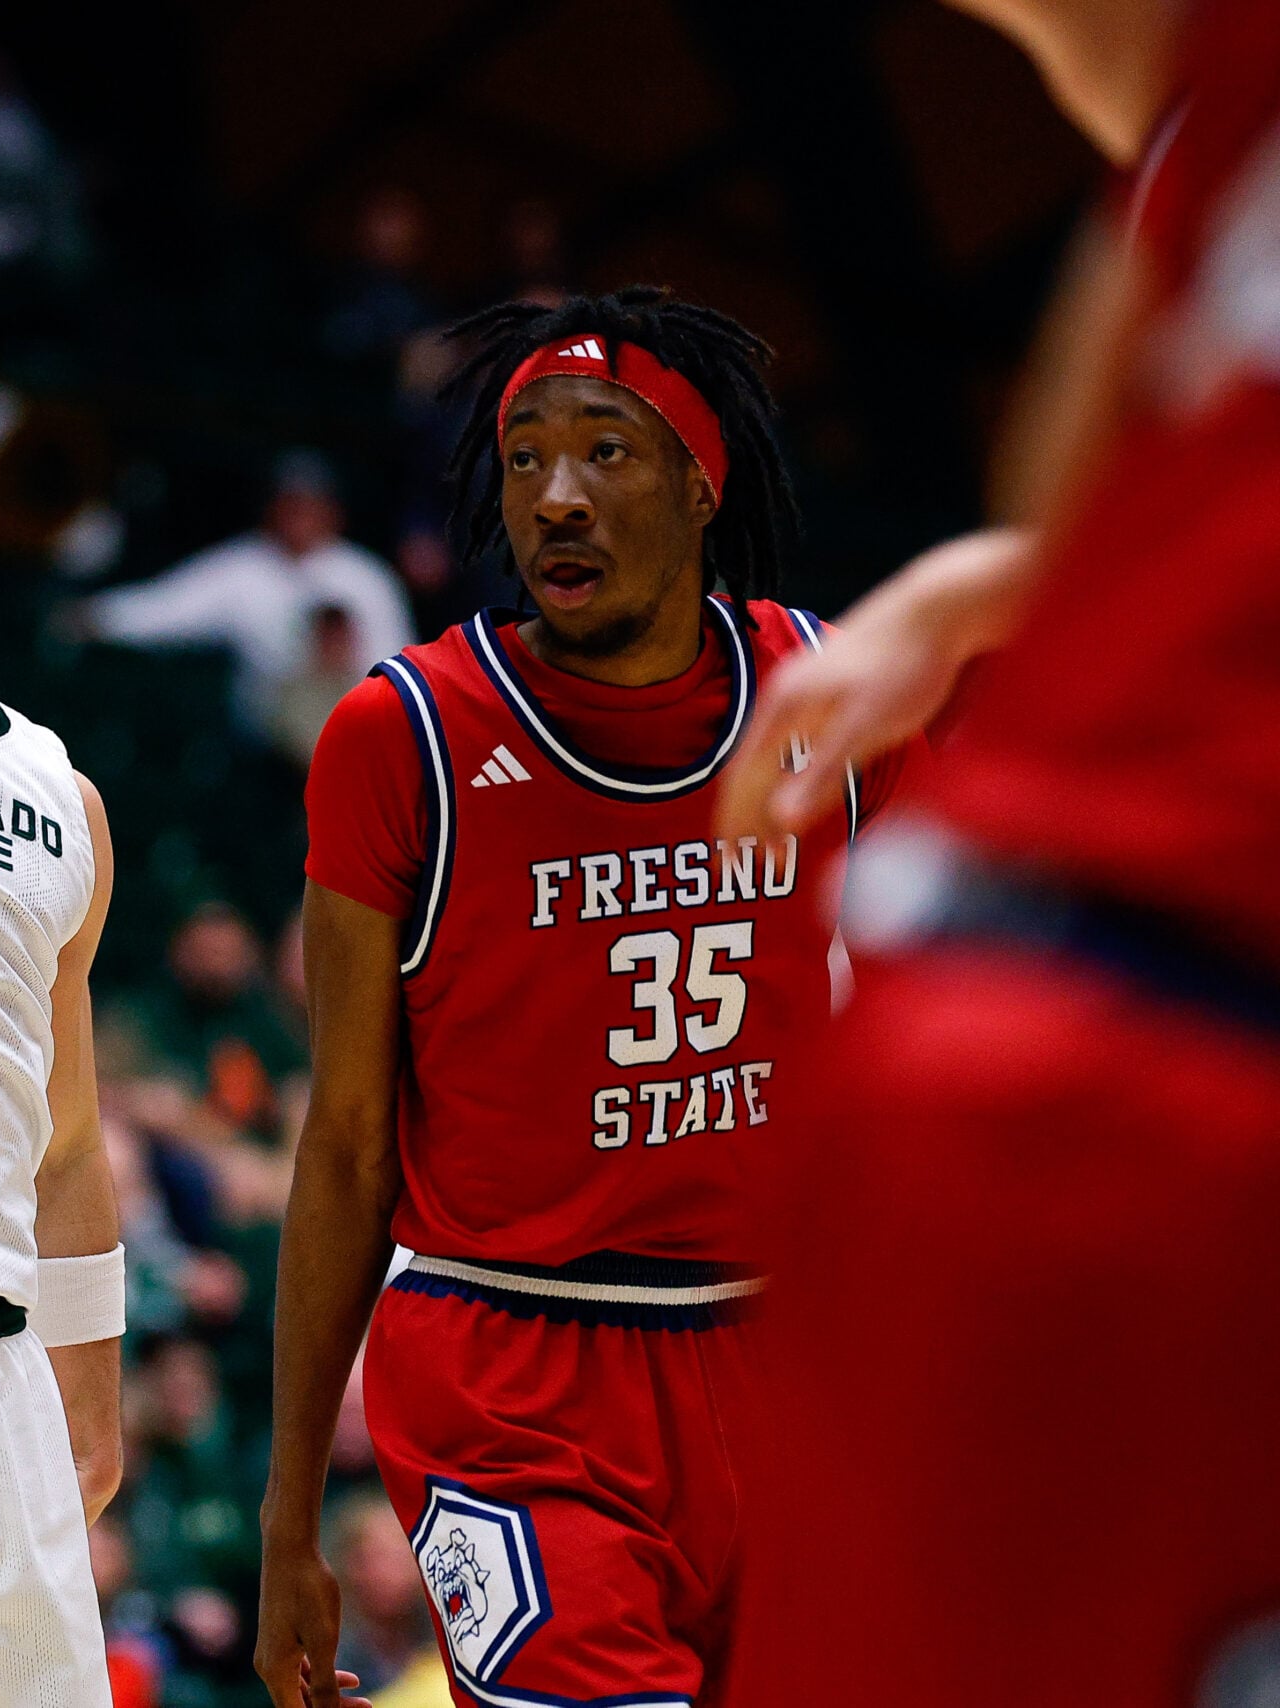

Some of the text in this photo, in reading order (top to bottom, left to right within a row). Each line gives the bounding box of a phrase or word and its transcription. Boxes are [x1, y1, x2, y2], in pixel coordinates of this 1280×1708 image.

[530, 832, 798, 929] FRESNO
[607, 920, 755, 1067] 35
[592, 1061, 774, 1150] STATE
